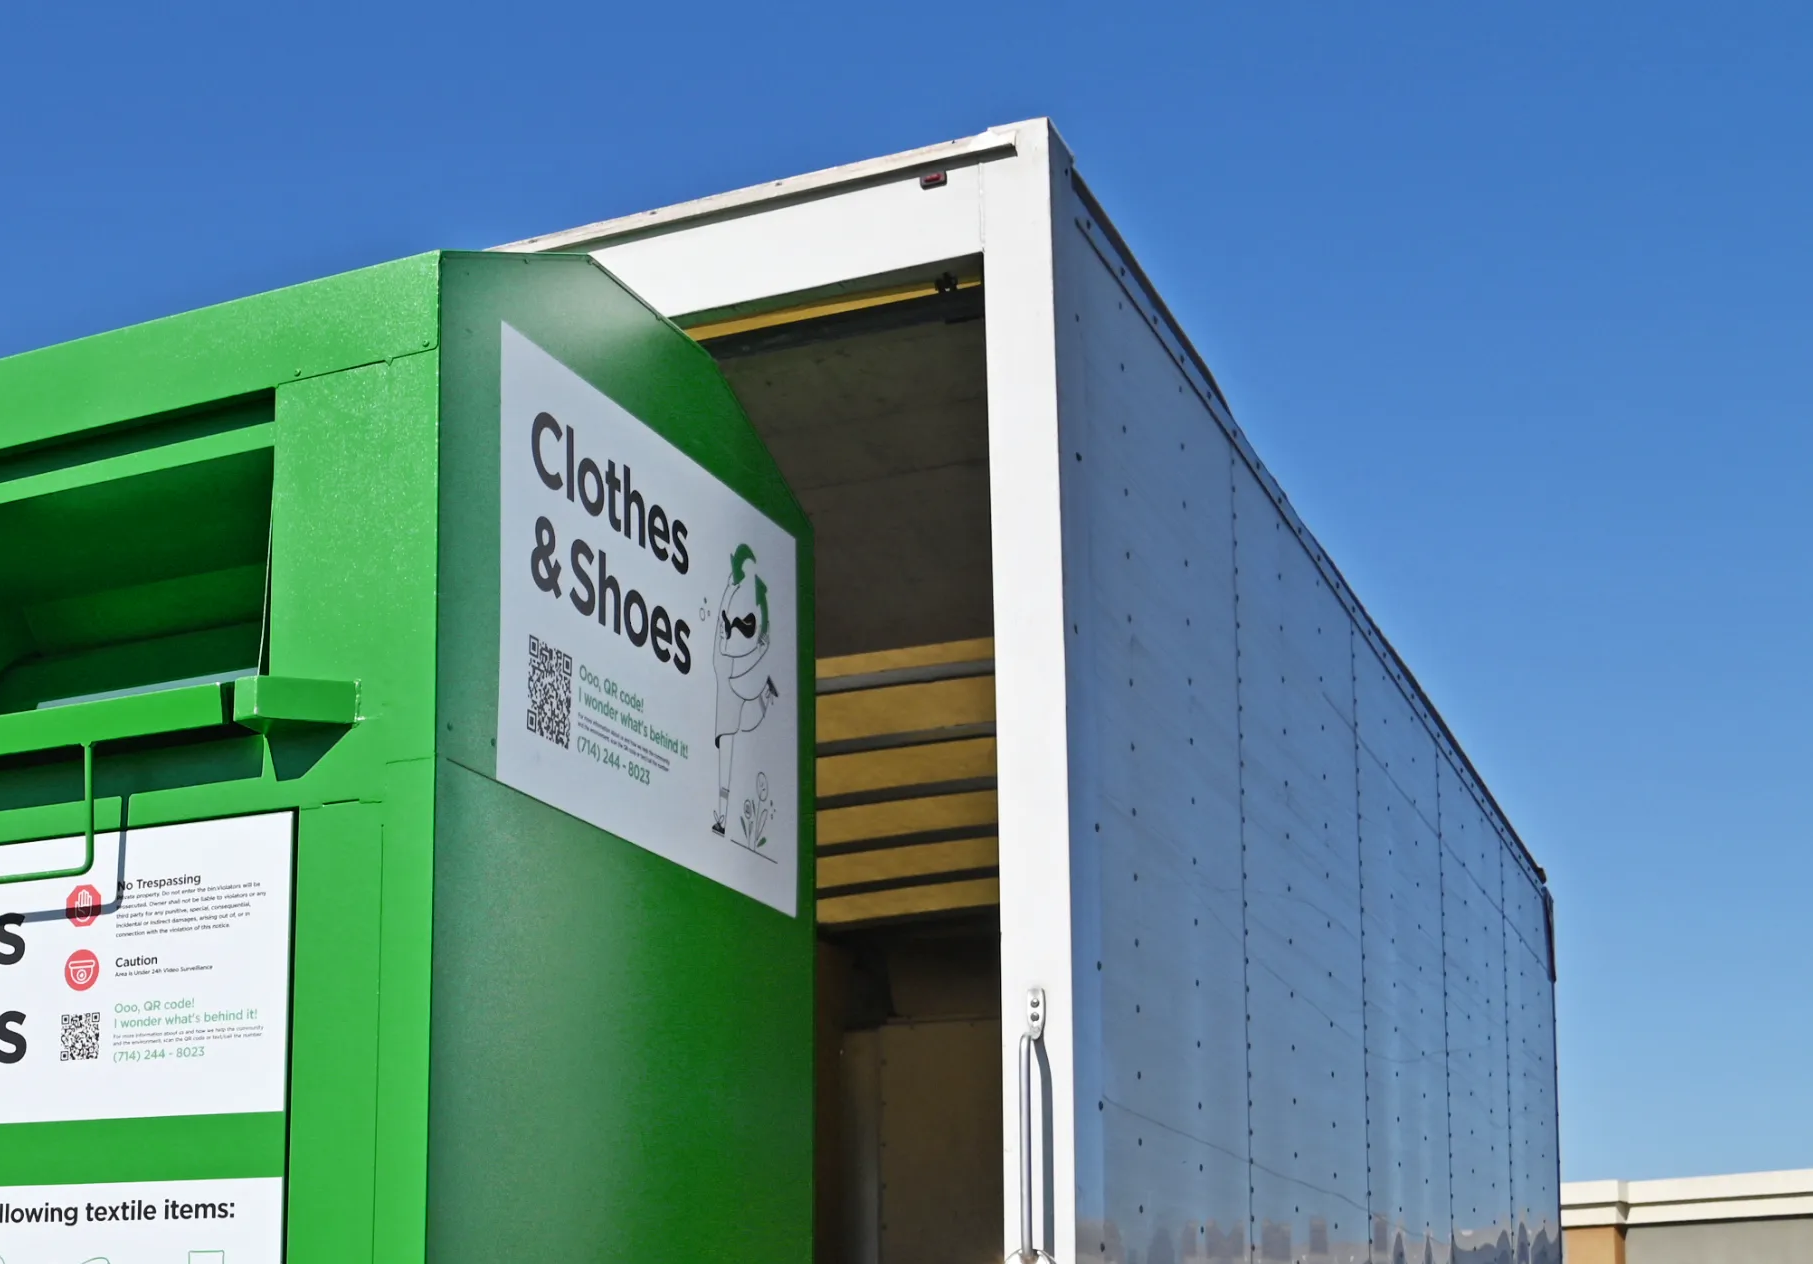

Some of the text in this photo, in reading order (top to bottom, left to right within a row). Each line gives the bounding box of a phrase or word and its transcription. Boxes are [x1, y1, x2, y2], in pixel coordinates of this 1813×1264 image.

[531, 411, 689, 576] Clothes
[530, 516, 691, 675] & Shoes
[604, 678, 618, 699] QR
[620, 690, 644, 713] code!
[584, 693, 618, 722] wonder
[620, 712, 648, 737] what's
[650, 724, 678, 754] behind
[680, 741, 688, 759] it!
[577, 736, 600, 762] (714)
[603, 748, 620, 770] 244
[628, 761, 650, 785] 8023
[117, 874, 201, 891] No Trespassing
[115, 955, 158, 968] Caution
[144, 1000, 160, 1013] QR
[164, 998, 194, 1010] code!
[121, 1016, 162, 1028] wonder
[165, 1013, 201, 1025] what's
[204, 1010, 243, 1022] behind
[246, 1009, 258, 1019] it!
[113, 1050, 140, 1064] (714)
[144, 1049, 165, 1060] 244
[176, 1046, 205, 1058] 8023
[85, 1199, 157, 1222] textile
[164, 1199, 235, 1220] items:
